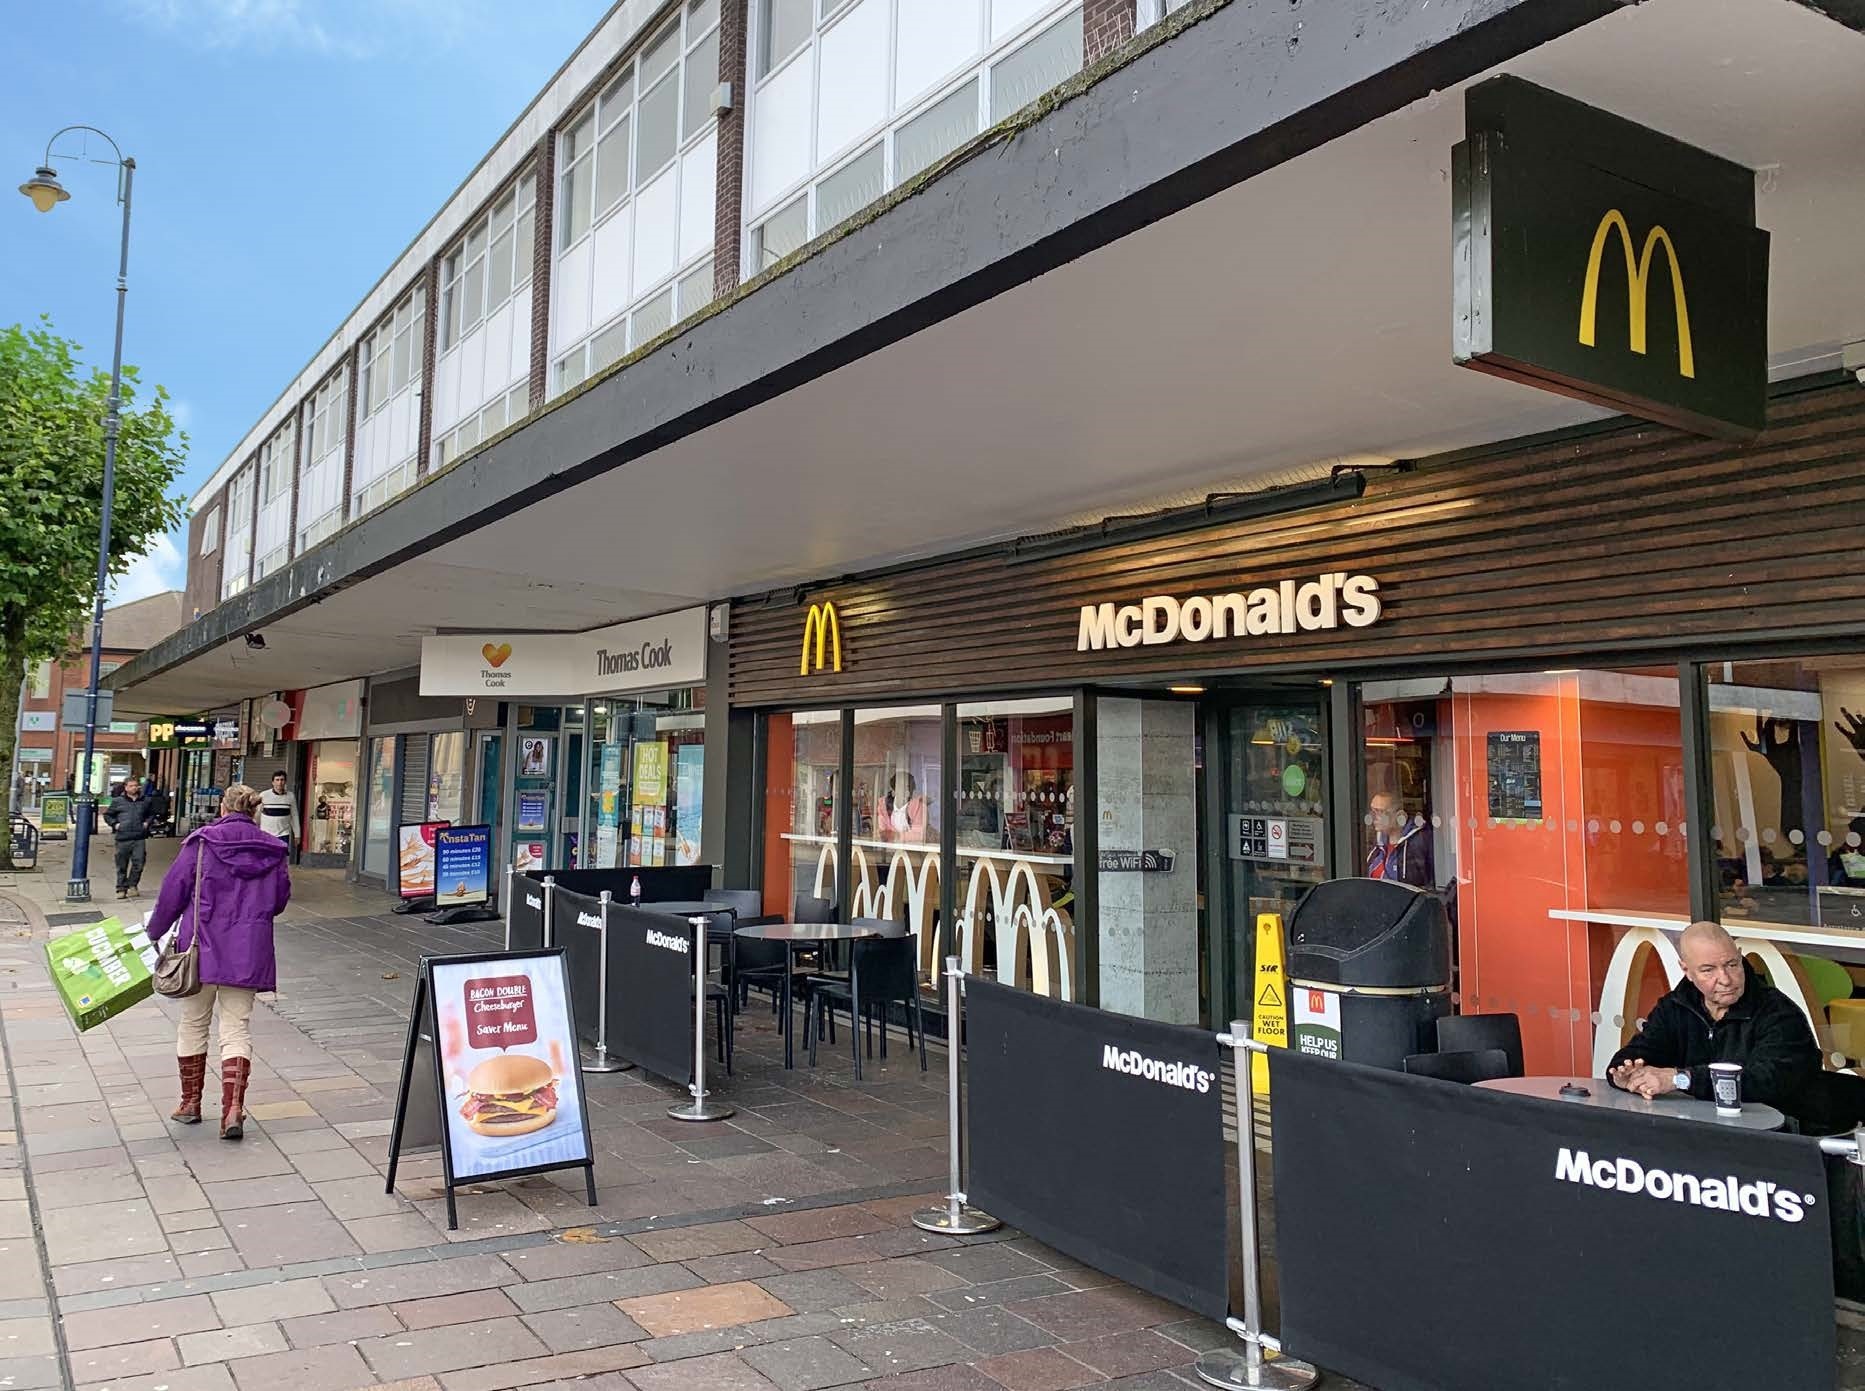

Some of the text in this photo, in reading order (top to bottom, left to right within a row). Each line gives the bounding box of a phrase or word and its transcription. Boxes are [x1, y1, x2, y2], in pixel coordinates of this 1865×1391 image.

[1077, 572, 1382, 651] McDonald's
[597, 638, 672, 676] Thomas Cook
[480, 670, 512, 679] Thomas
[485, 679, 505, 688] Cook
[1511, 733, 1526, 742] Menu
[642, 747, 658, 762] HOT
[639, 764, 661, 779] DEALS
[470, 985, 527, 999] BACON DOUBLE
[474, 1000, 525, 1013] Cheeseburger
[476, 1021, 528, 1035] Saver Menu
[1258, 1027, 1285, 1035] FLOOR
[1262, 1020, 1280, 1028] WET
[1300, 1034, 1338, 1051] HELP US
